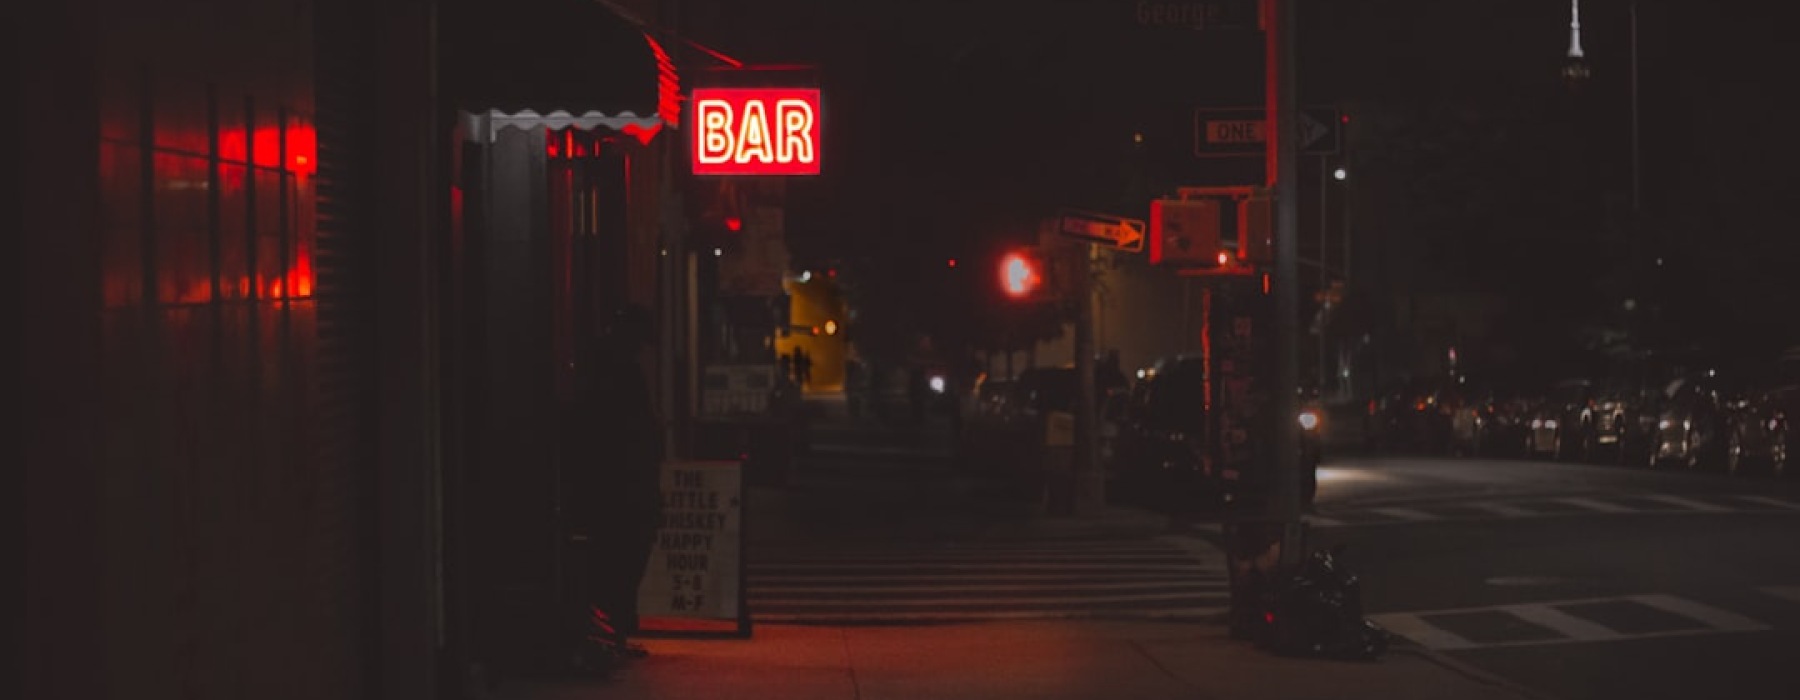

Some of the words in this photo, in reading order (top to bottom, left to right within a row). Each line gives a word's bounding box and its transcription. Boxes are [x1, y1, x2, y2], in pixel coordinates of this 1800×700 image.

[1137, 1, 1219, 31] George
[697, 99, 814, 164] BAR
[1217, 123, 1256, 139] ONE
[673, 470, 705, 487] THE
[660, 532, 714, 551] HAPPY
[667, 554, 708, 571] HOUR
[671, 595, 704, 611] M-F
